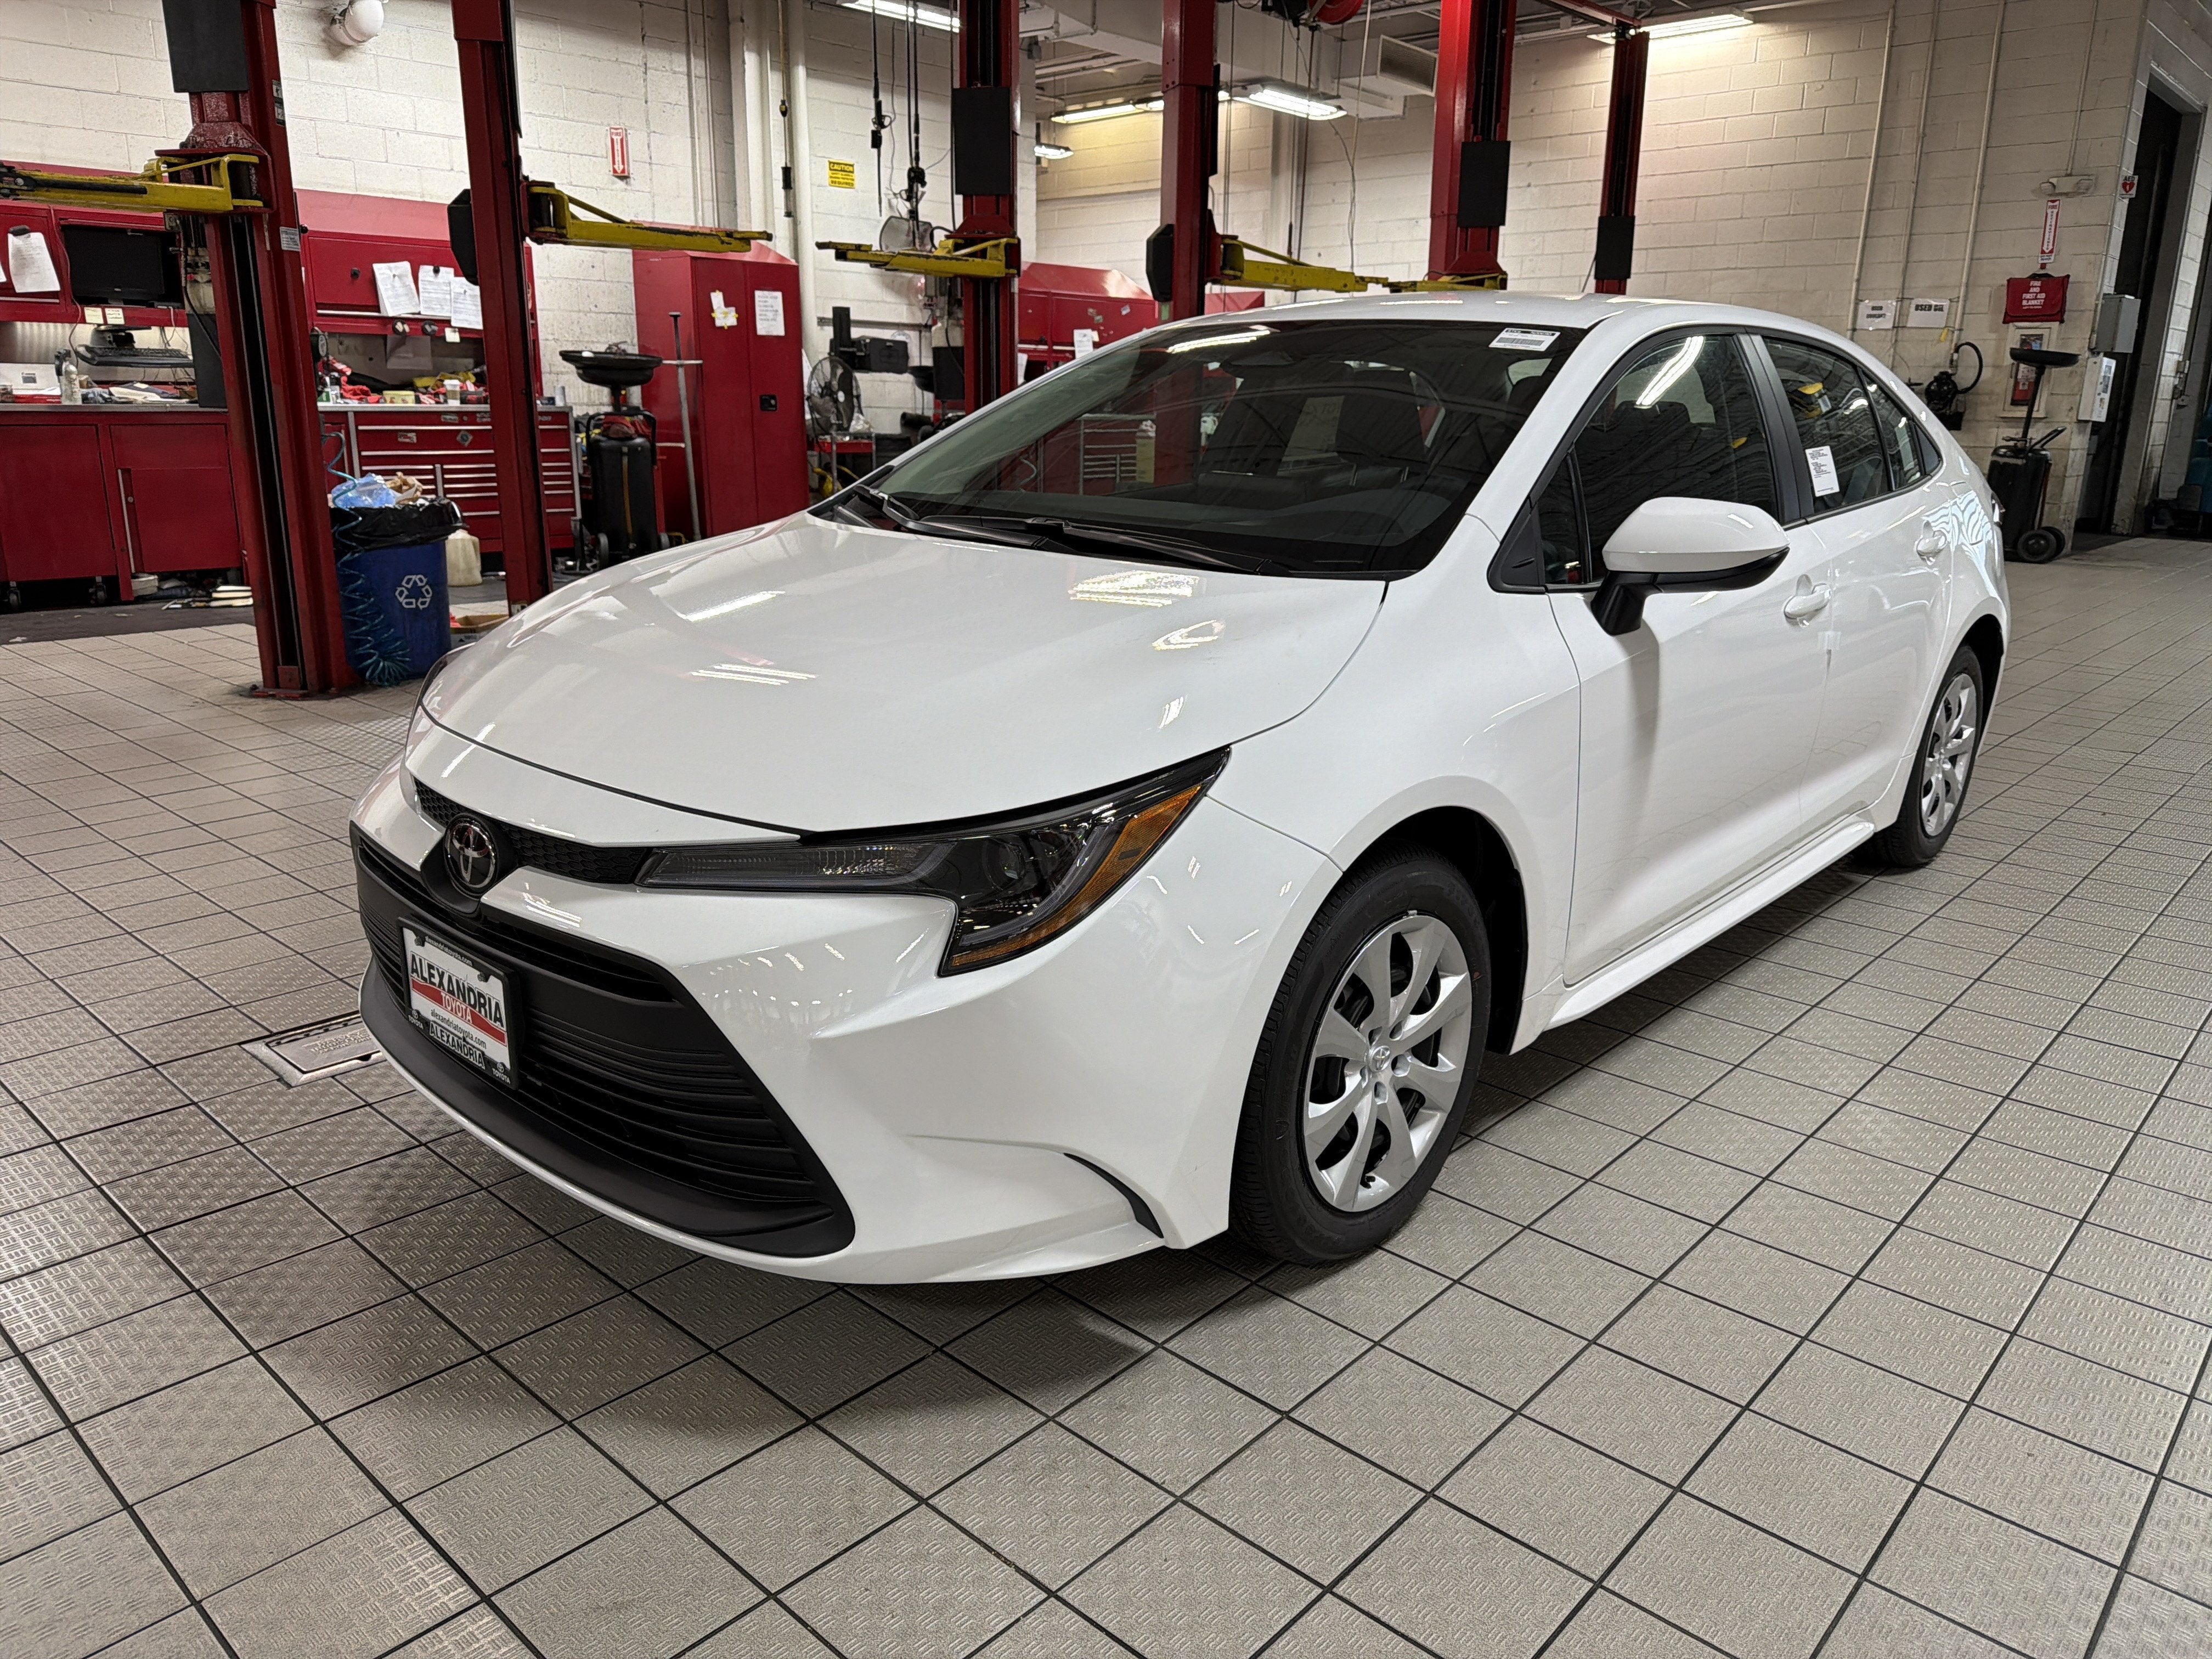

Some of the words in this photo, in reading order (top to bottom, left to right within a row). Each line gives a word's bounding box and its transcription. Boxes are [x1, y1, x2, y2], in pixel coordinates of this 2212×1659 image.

[410, 953, 504, 1028] ALEXANDRIA
[441, 991, 473, 1024] TOYOTA
[408, 1014, 424, 1030] TOYOTA
[431, 1008, 487, 1049] alexandriatoyota.com
[430, 1021, 486, 1070] ALEXANDRIA
[492, 1068, 511, 1084] TOYOTA
